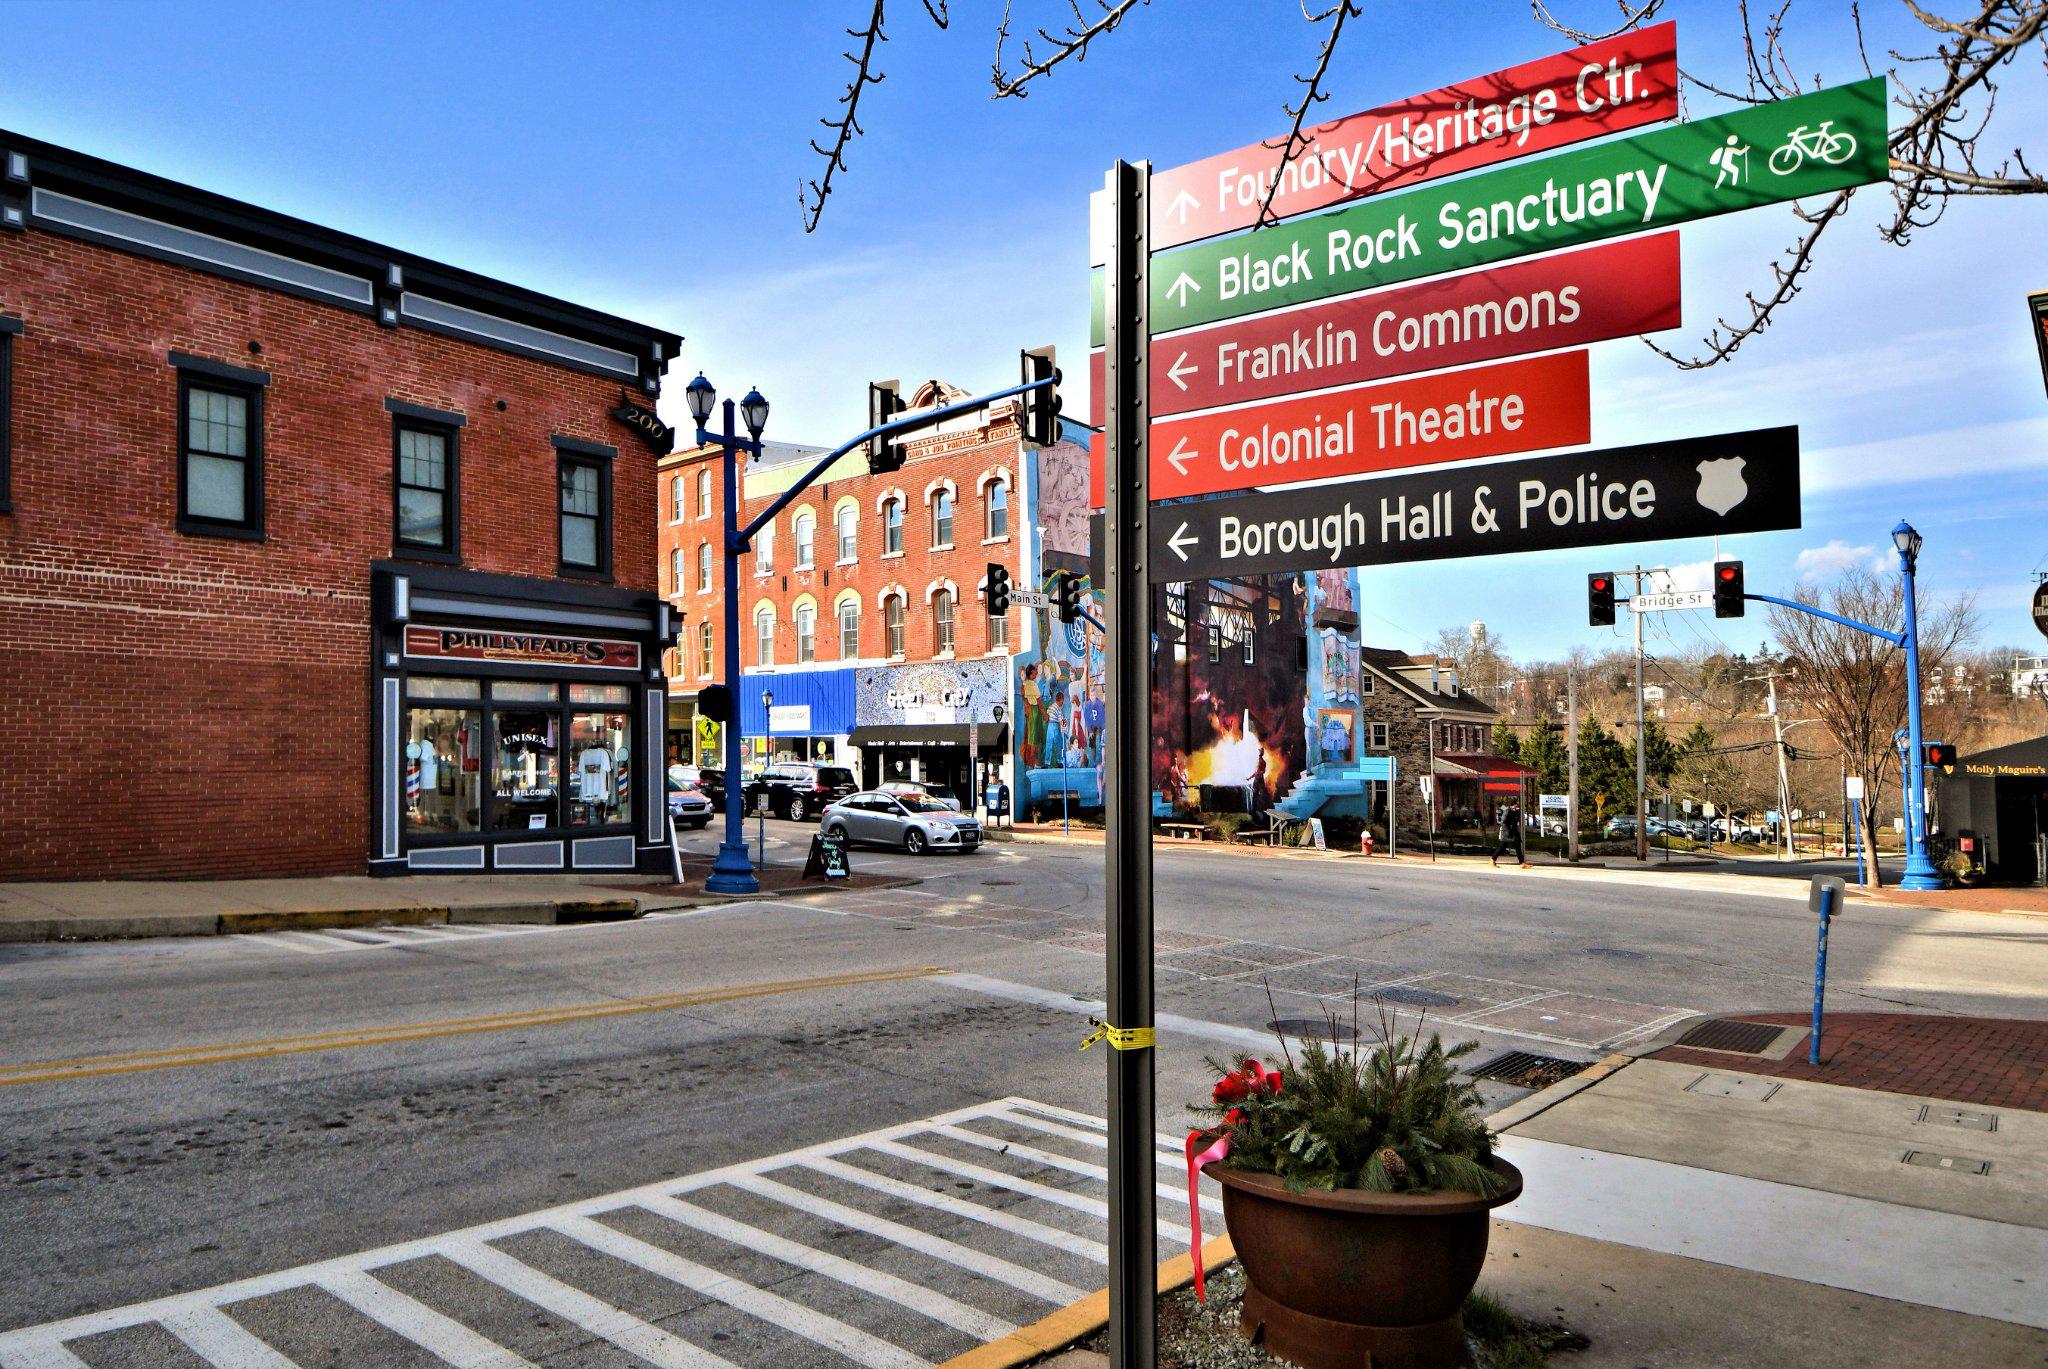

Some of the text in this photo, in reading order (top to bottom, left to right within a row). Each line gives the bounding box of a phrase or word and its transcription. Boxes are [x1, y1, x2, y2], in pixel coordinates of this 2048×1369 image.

[1219, 56, 1648, 212] Foundry/Heritage Ctr.
[1219, 164, 1668, 301] Black Rock Sanctuary
[1218, 285, 1581, 386] Franklin Commons
[627, 408, 663, 438] 200
[1219, 389, 1525, 472] Colonial Theatre
[1219, 472, 1656, 562] Borough Hall & Police
[1010, 593, 1041, 606] Main St
[1639, 594, 1702, 608] Bridge St
[502, 733, 548, 745] UNISEX
[1966, 764, 2046, 776] Molly Maguire's
[496, 788, 552, 797] ALL WELCOME
